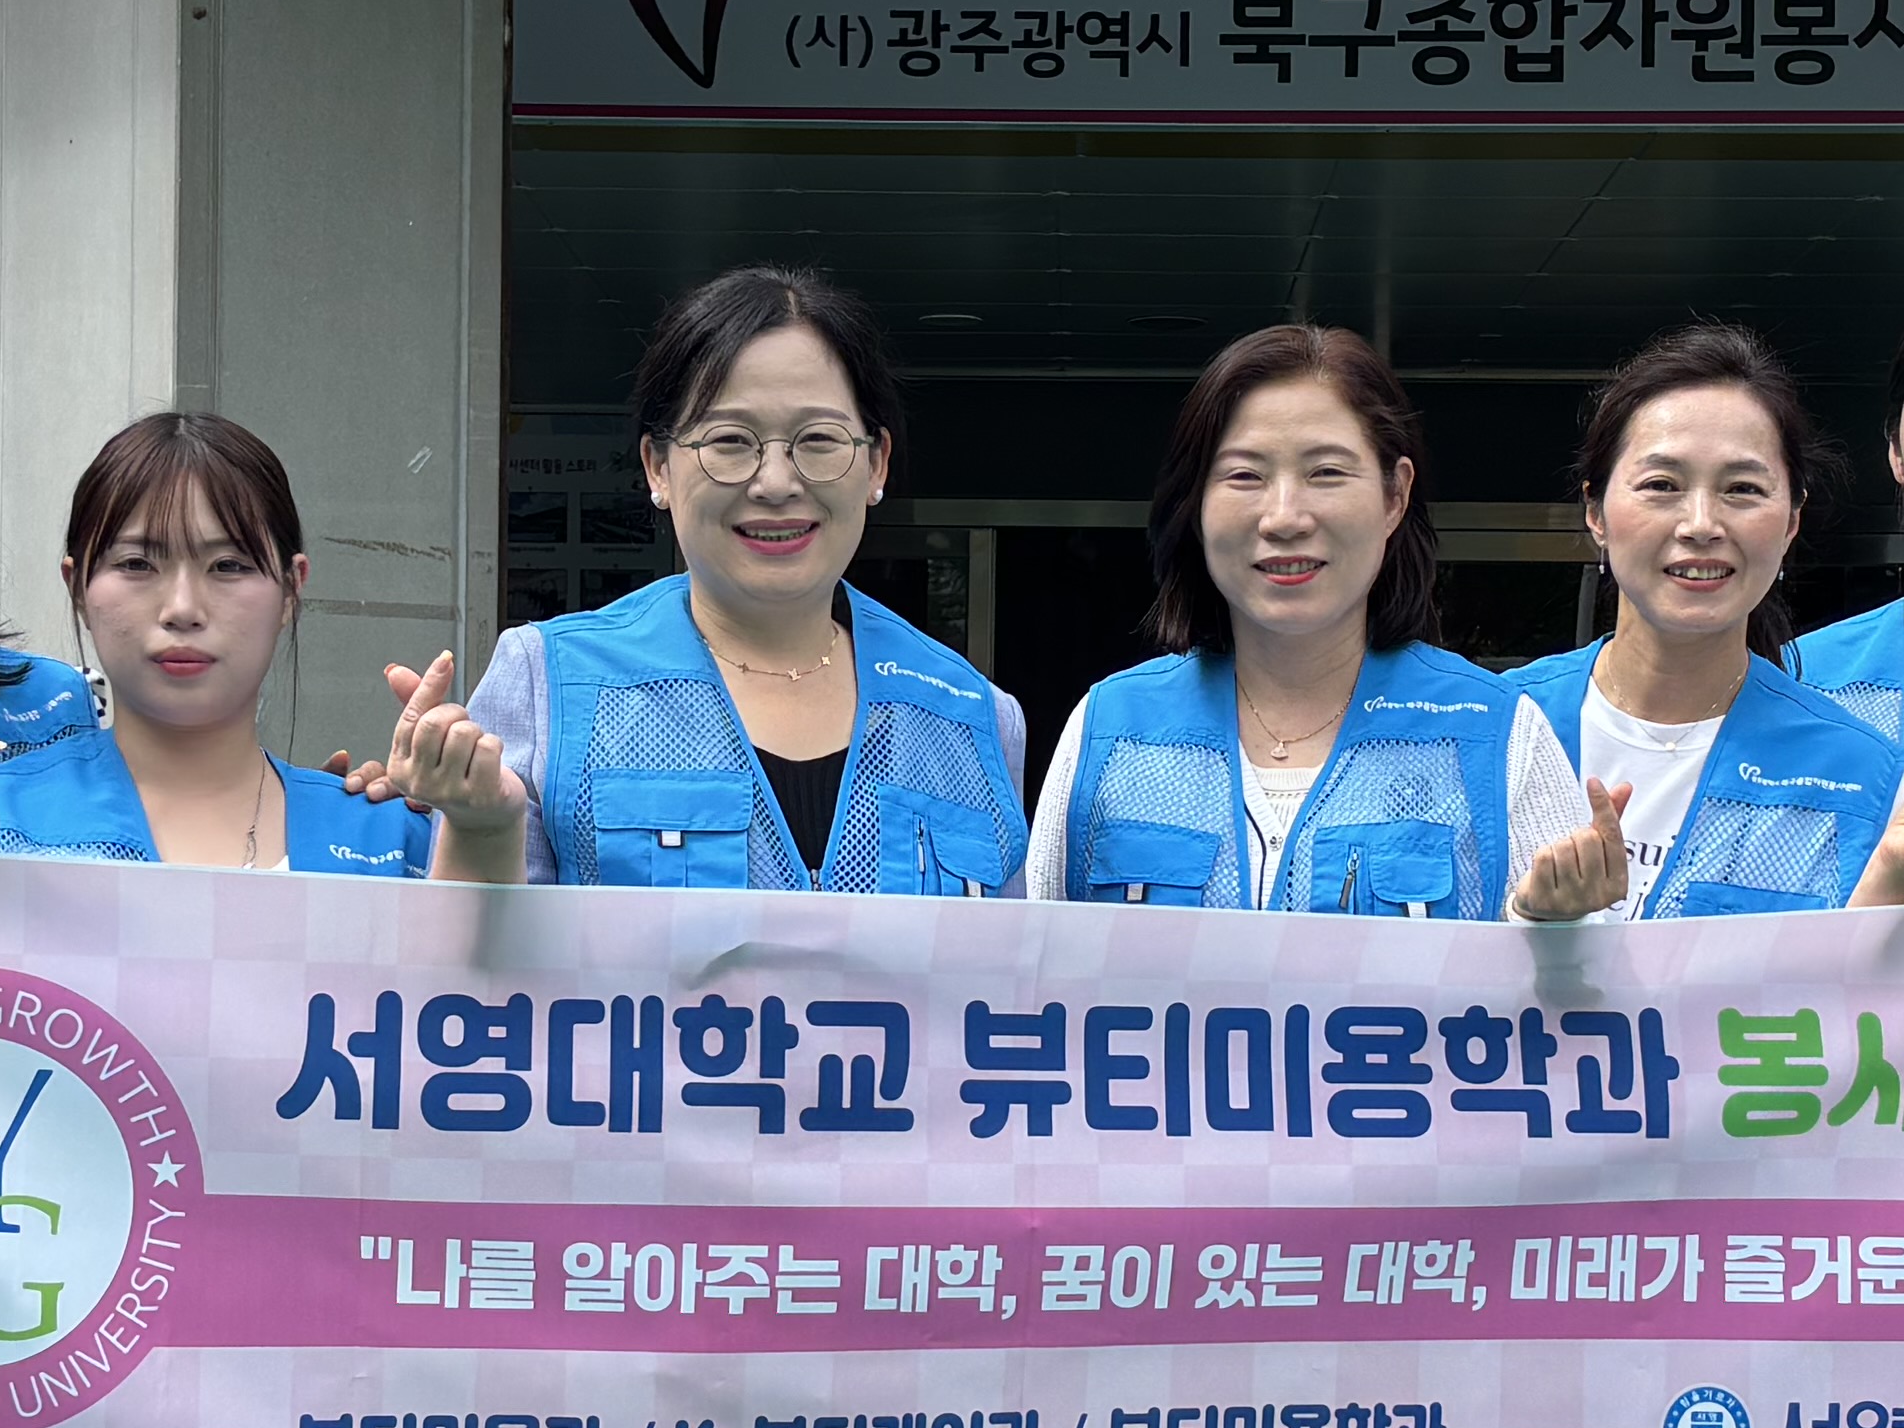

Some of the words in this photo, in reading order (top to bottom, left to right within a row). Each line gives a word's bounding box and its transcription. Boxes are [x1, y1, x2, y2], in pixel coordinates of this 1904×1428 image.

[276, 990, 915, 1135] 서영대학교
[959, 999, 1680, 1140] 뷰티미용학과
[8, 1198, 186, 1418] UNIVERSITY
[360, 1235, 536, 1310] "나를
[562, 1242, 841, 1315] 알아주는
[864, 1244, 1017, 1320] 대학,
[1041, 1244, 1174, 1311] 꿈이
[1194, 1243, 1323, 1309] 있는
[1343, 1239, 1487, 1312] 대학,
[1510, 1234, 1705, 1303] 미래가
